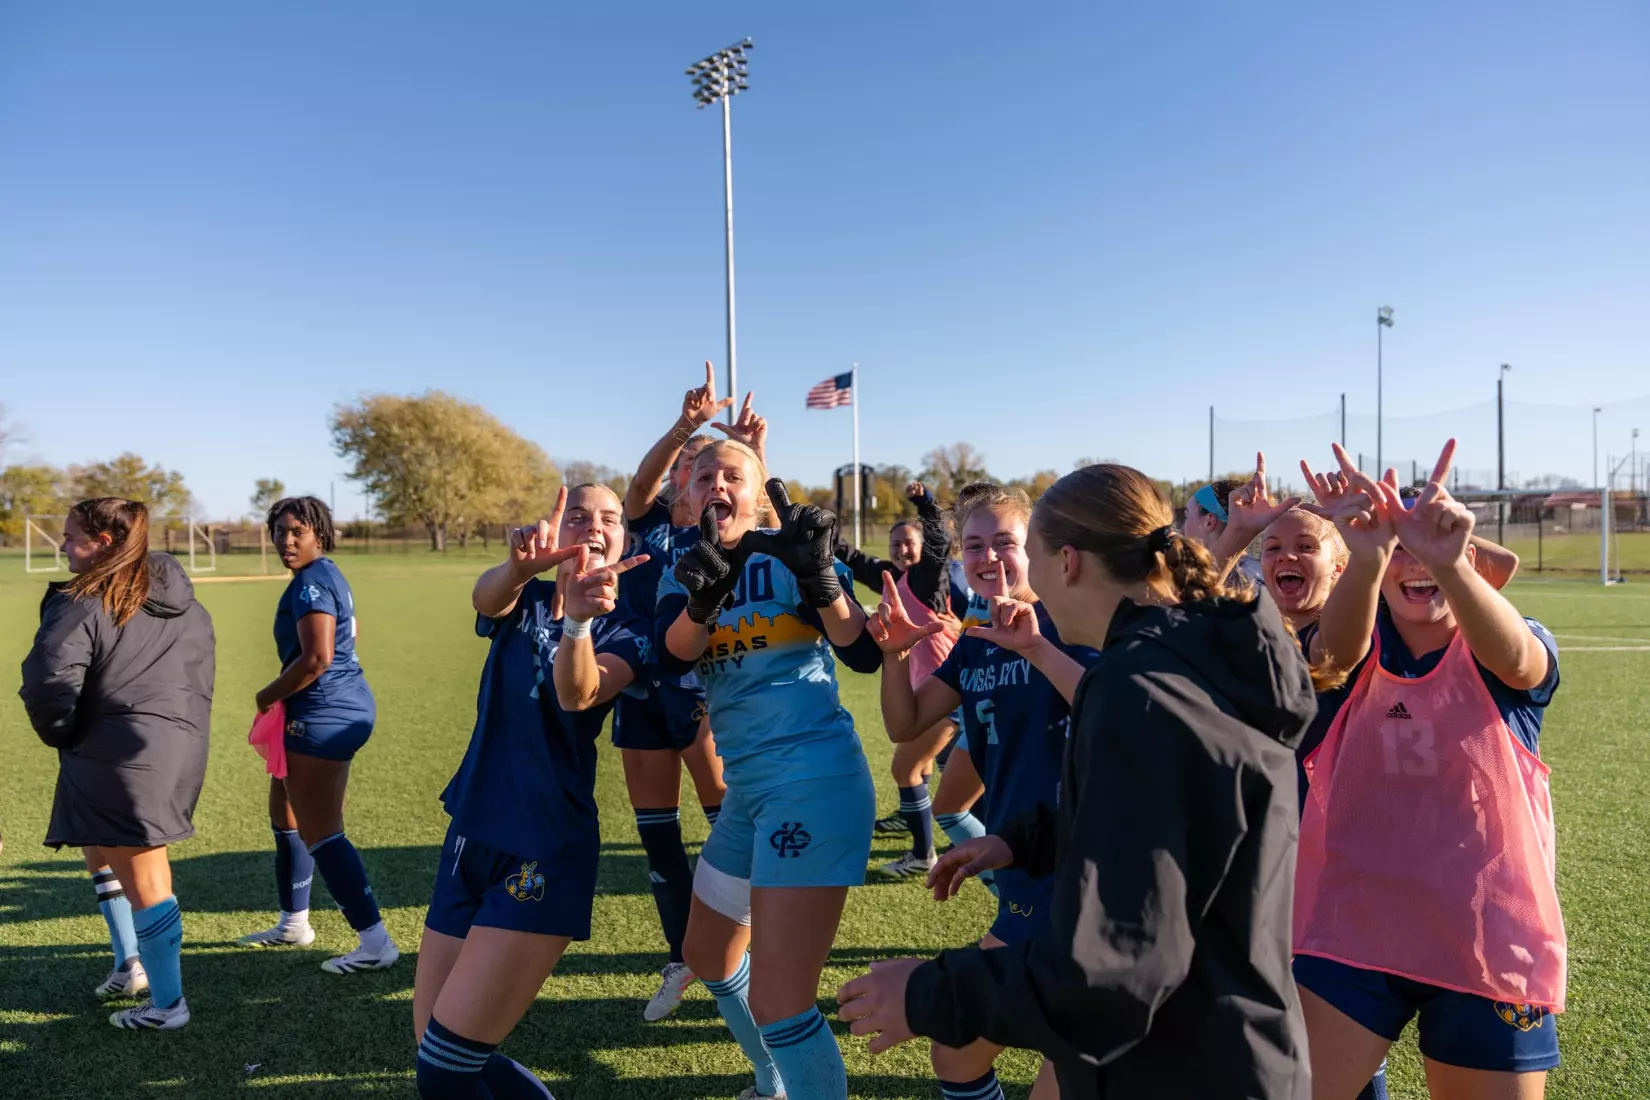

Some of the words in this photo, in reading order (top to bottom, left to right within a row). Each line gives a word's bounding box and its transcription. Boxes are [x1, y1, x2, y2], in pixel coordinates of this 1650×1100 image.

[701, 635, 768, 660] NSAS
[700, 655, 745, 675] CITY
[1386, 711, 1412, 720] adidas
[1380, 719, 1439, 777] 13
